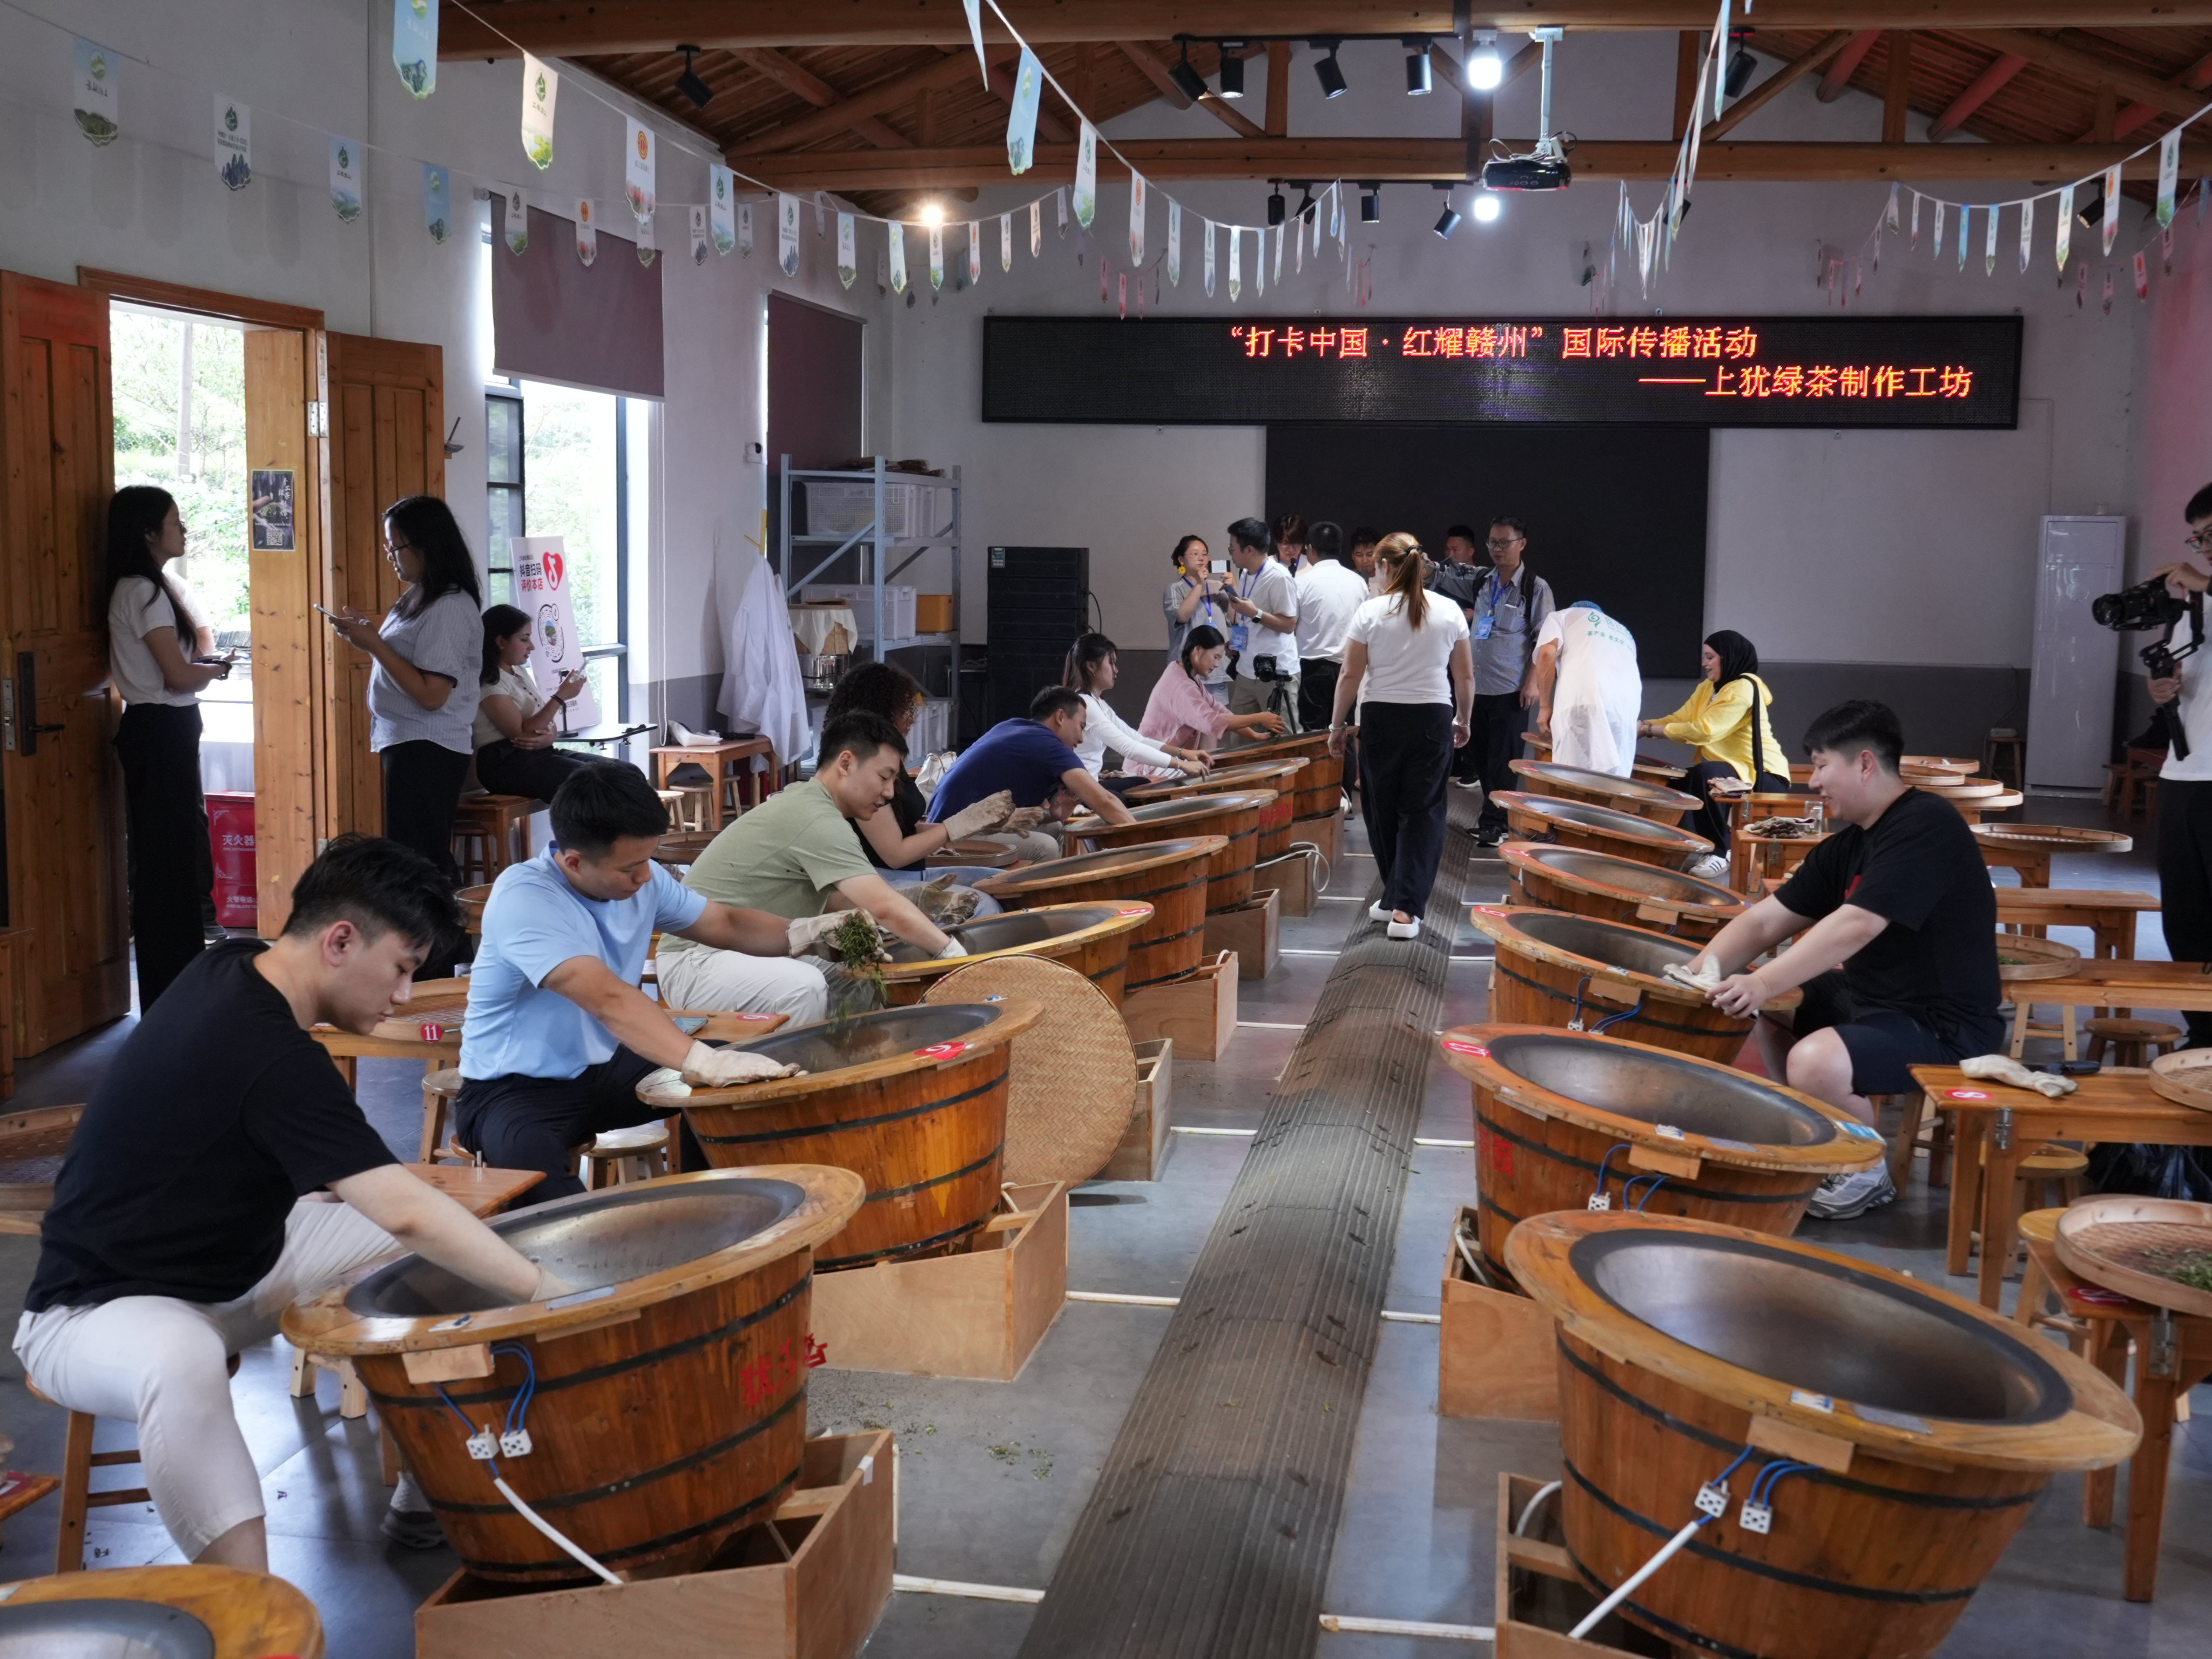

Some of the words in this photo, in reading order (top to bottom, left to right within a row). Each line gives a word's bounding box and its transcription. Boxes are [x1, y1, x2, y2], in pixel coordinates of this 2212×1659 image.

[1562, 326, 1757, 359] 国际传播活动
[520, 563, 542, 577] 抖音扫码
[521, 578, 543, 592] 评价本店
[222, 835, 255, 846] 灭火器
[424, 1024, 439, 1041] 11
